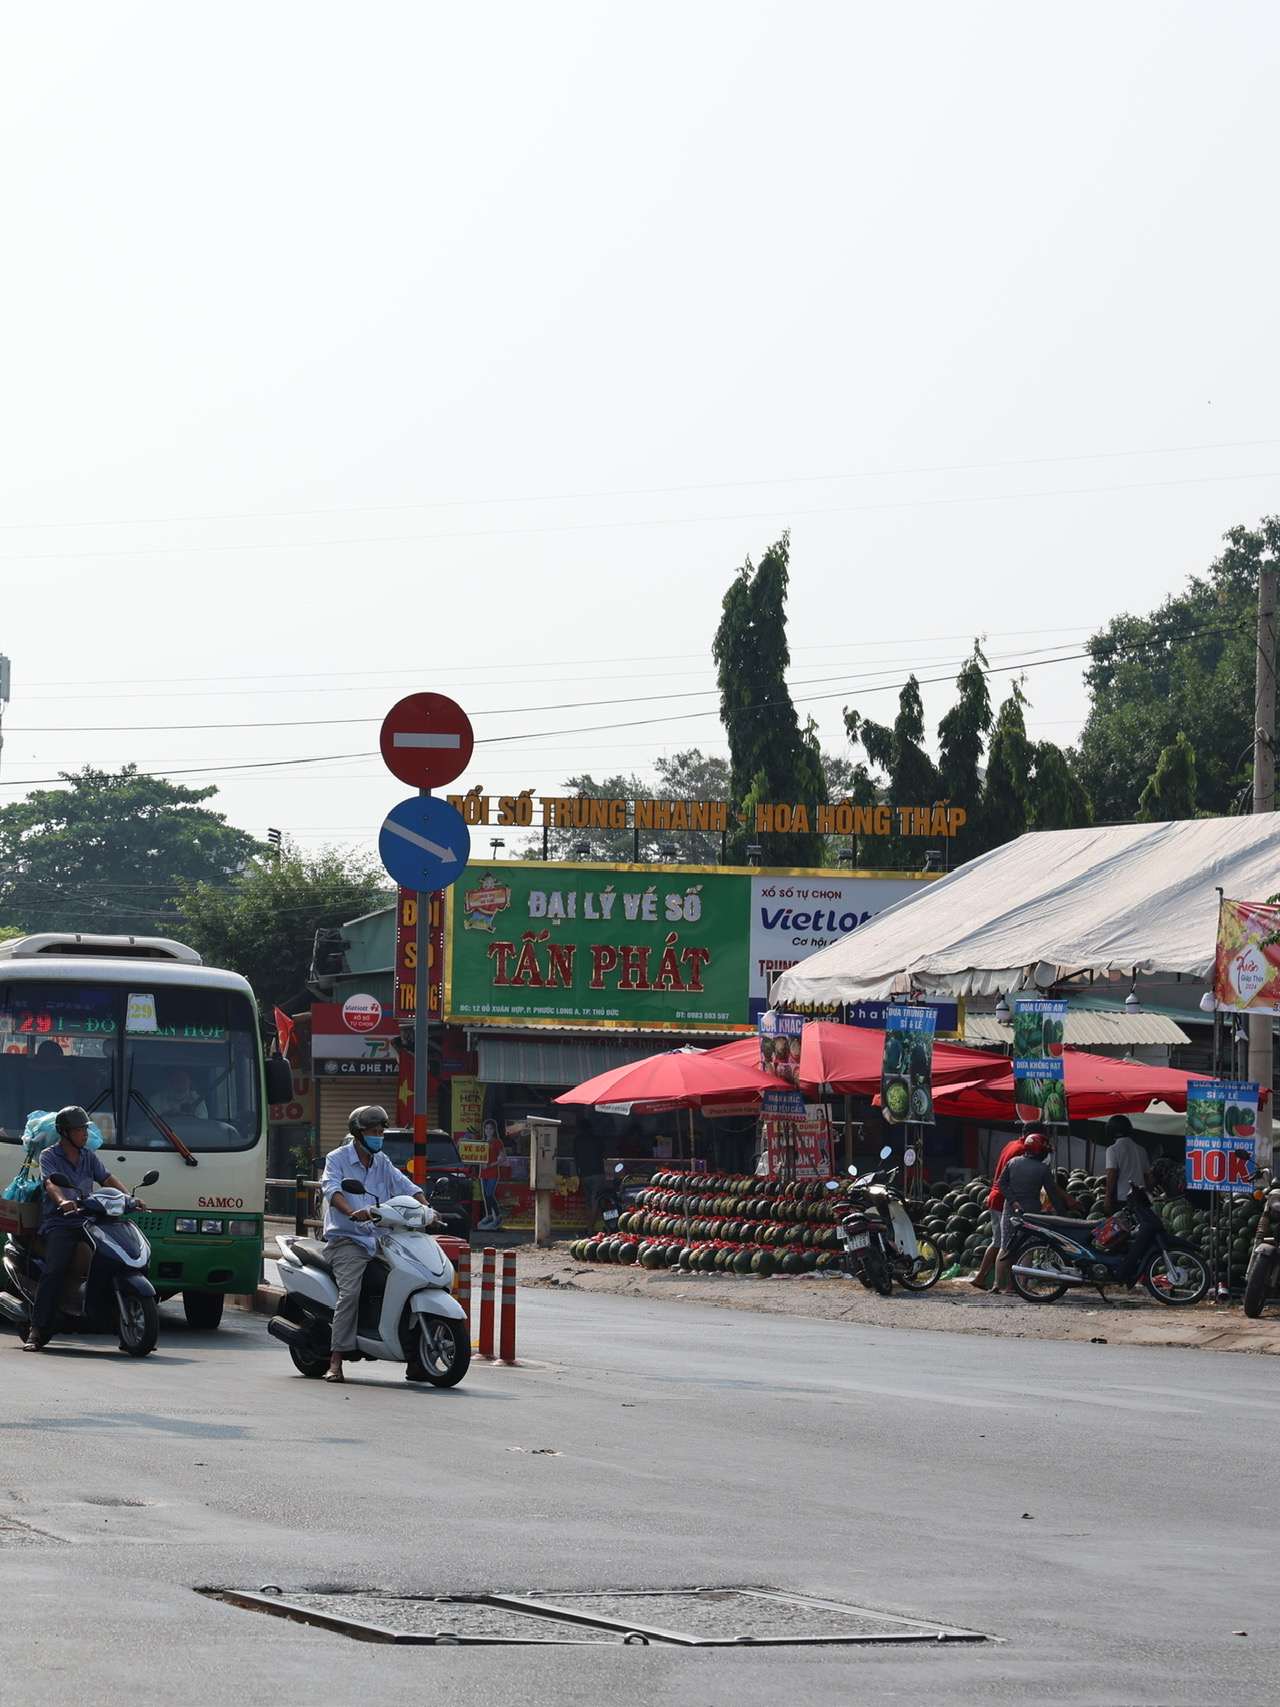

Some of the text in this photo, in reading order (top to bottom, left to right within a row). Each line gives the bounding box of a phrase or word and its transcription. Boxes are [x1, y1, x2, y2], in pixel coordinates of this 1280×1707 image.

[498, 789, 535, 828] SỐ
[540, 792, 627, 831] TRÚNG
[634, 799, 727, 833] NHANH
[757, 803, 810, 834] HOA
[818, 797, 892, 836] HỒNG
[897, 798, 967, 838] THẤP
[762, 884, 842, 900] XỔ SỐ TỰ CHỌN
[402, 893, 440, 927] ĐI
[528, 884, 704, 926] ĐẠI LÝ VÉ SỐ
[761, 906, 880, 932] Vietlot
[792, 937, 828, 948] Cơ hội
[486, 929, 712, 992] TẤN PHÁT
[400, 984, 438, 1011] TRG
[130, 1003, 154, 1020] 29
[491, 1004, 509, 1012] XUÂN
[533, 1006, 555, 1014] PHƯỚC
[592, 1006, 605, 1016] THỦ
[606, 1007, 619, 1016] ĐỨC
[704, 1012, 716, 1020] 593
[1053, 1003, 1064, 1012] AN
[19, 1010, 52, 1032] 29
[341, 1061, 382, 1073] CÀ PHÊ
[1186, 1148, 1253, 1185] 10K
[198, 1196, 243, 1208] SAMCO
